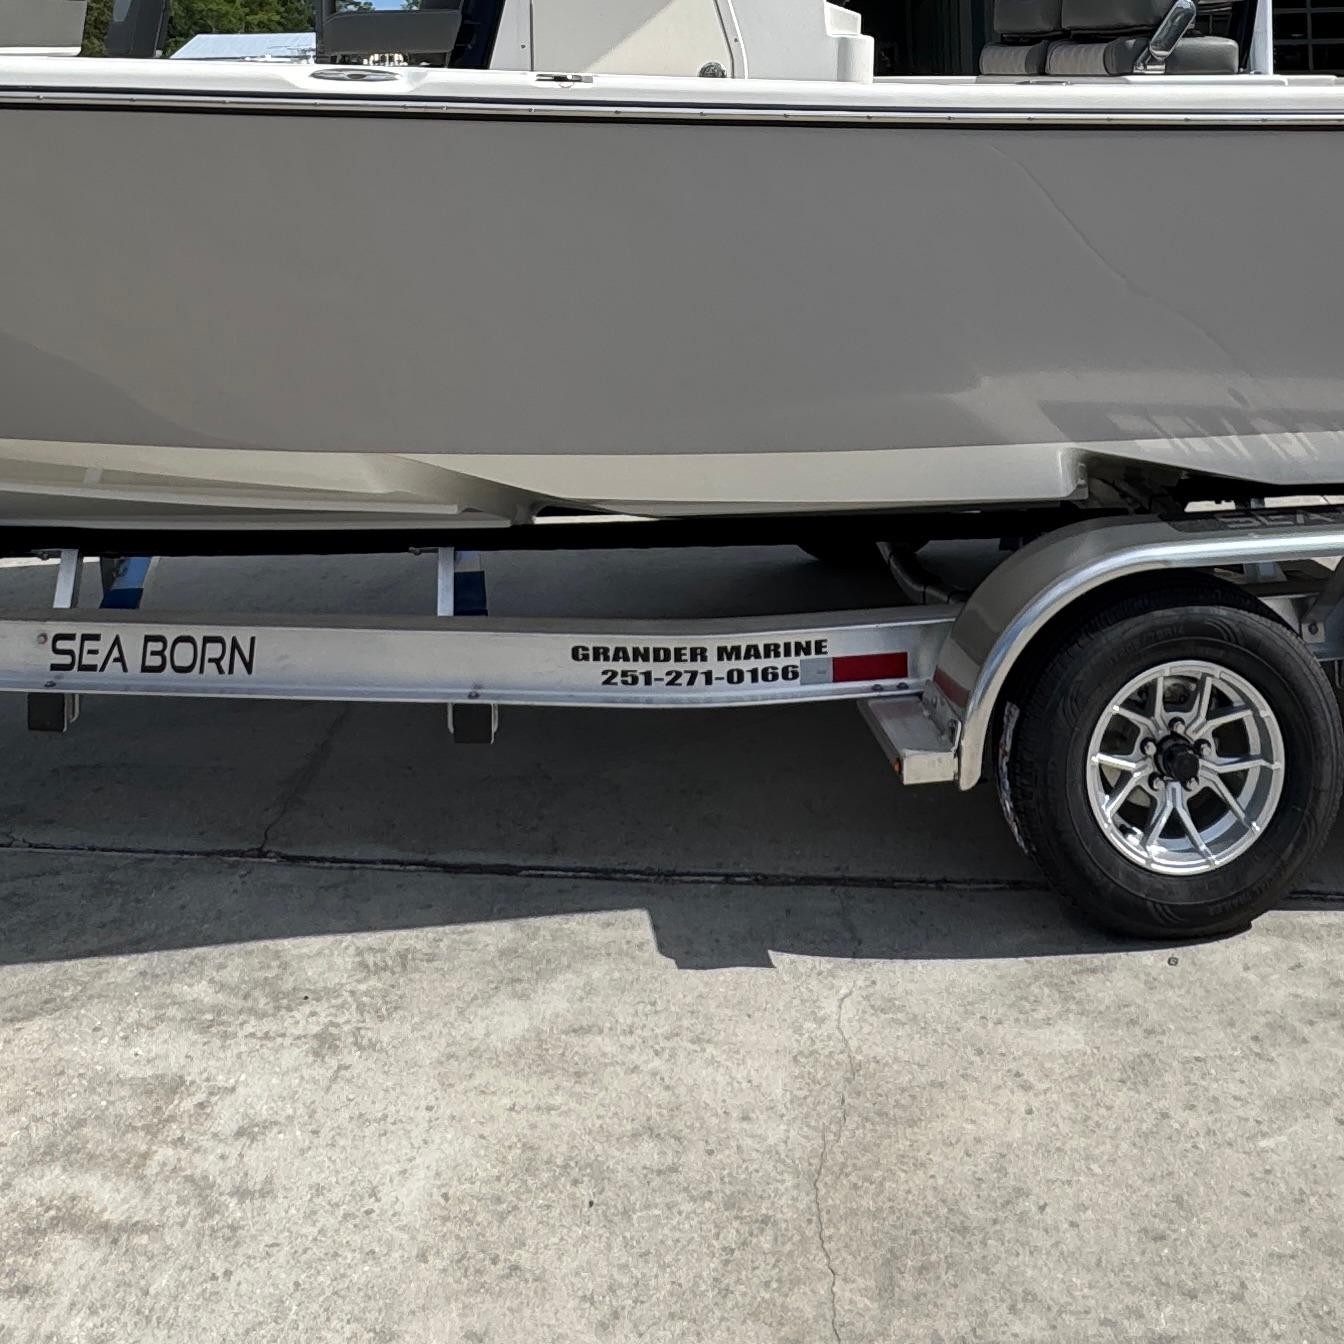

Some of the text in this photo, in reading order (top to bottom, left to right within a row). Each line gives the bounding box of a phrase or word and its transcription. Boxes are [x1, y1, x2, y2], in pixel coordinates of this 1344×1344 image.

[50, 633, 256, 675] SEA BORN
[571, 639, 828, 663] GRANDER MARINE
[601, 664, 800, 687] 251-271-0166
